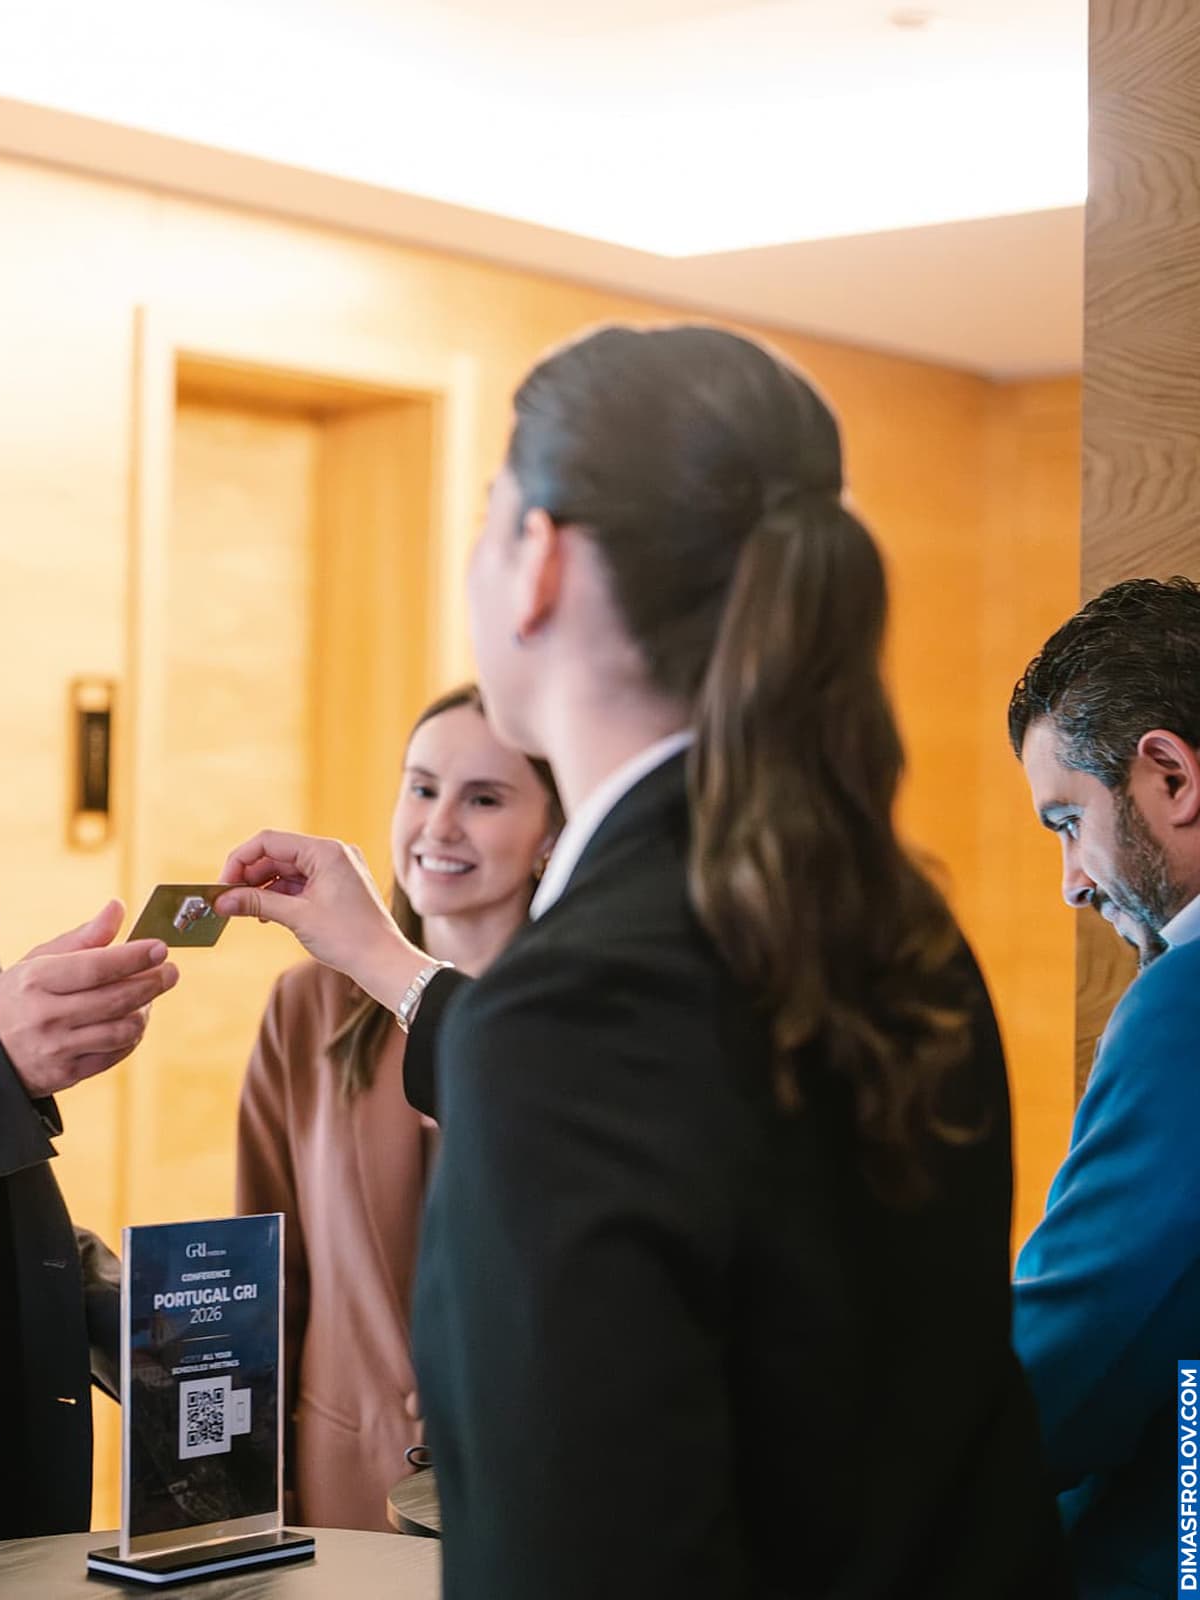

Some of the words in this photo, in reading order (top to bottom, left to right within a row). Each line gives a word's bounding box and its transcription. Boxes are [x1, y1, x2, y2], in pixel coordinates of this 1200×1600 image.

[186, 1242, 206, 1258] GRI
[154, 1287, 230, 1309] PORTUGAL
[233, 1284, 257, 1300] GRI
[190, 1305, 222, 1324] 2026
